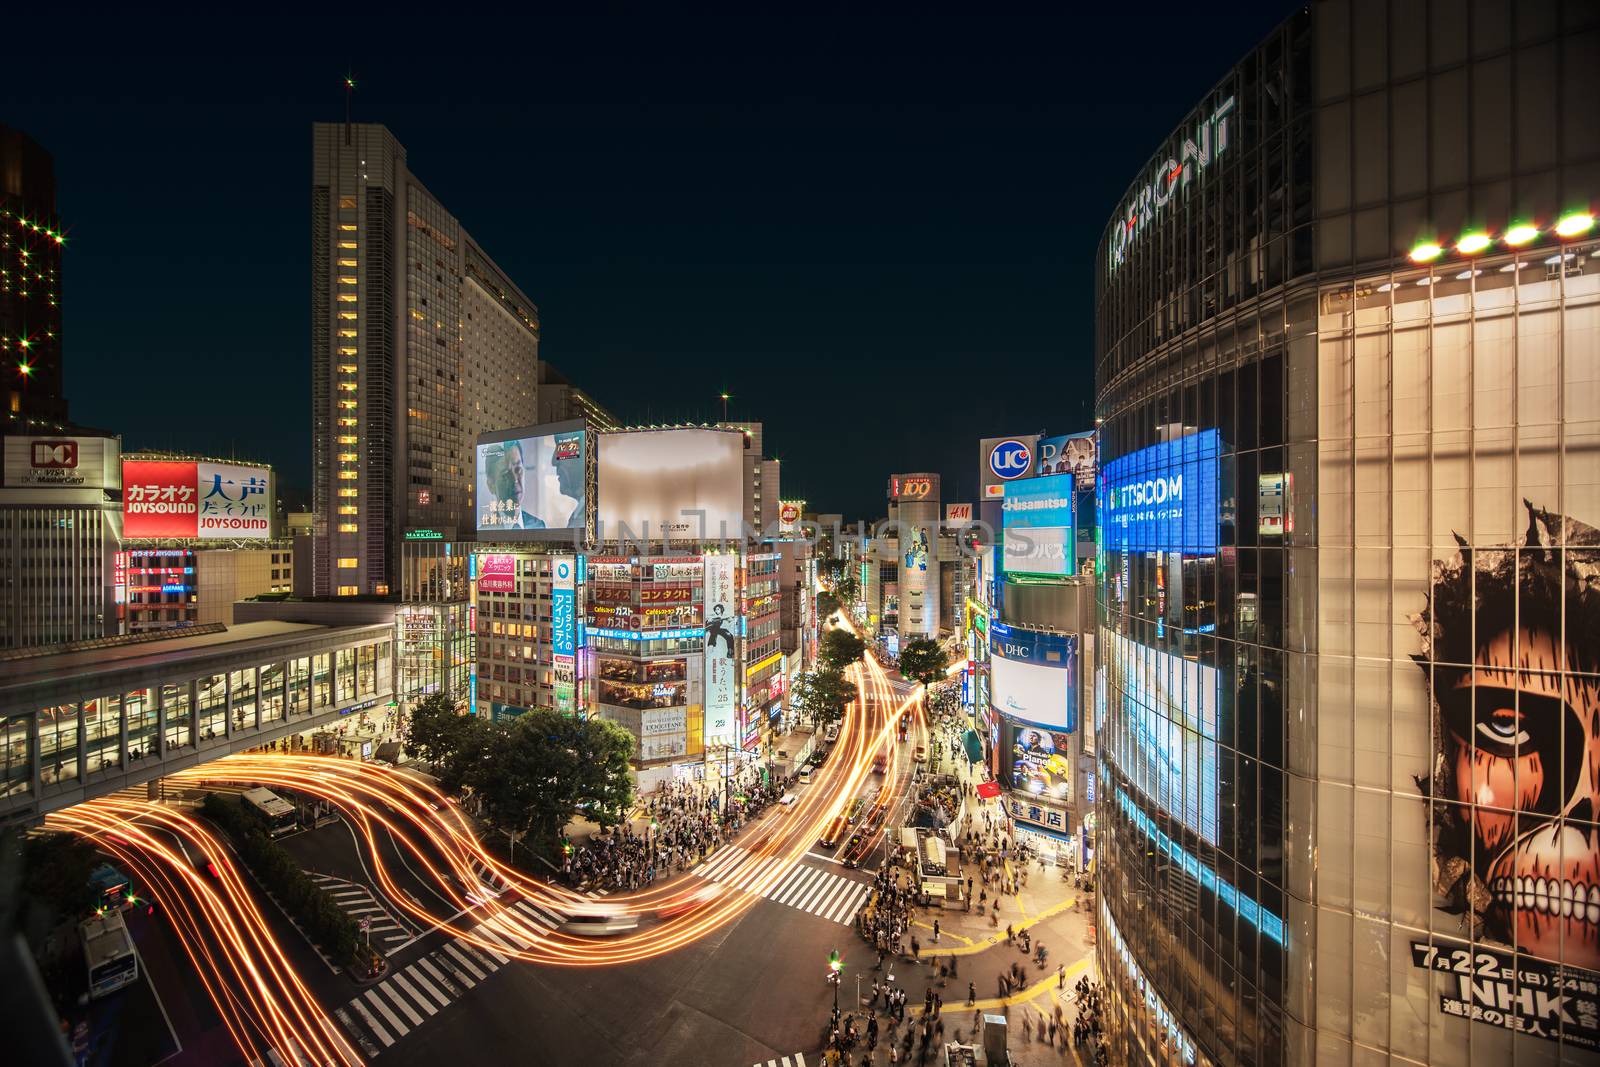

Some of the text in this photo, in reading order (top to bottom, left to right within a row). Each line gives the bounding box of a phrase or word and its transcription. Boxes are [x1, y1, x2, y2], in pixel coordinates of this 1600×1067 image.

[993, 450, 1028, 469] UC
[127, 485, 194, 501] カラオケ
[202, 474, 266, 501] 大声
[902, 482, 931, 499] 109
[127, 503, 196, 514] JOYSOUND
[1001, 498, 1068, 511] Hisamitsu
[950, 506, 969, 519] H&M
[201, 518, 267, 529] JOYSOUND
[641, 590, 690, 600] コンタクト
[555, 594, 564, 650] アイシティ
[607, 616, 628, 628] ガスト
[1005, 643, 1029, 657] DHC
[1459, 975, 1577, 1025] NHK
[1443, 998, 1548, 1038] 進撃の巨人
